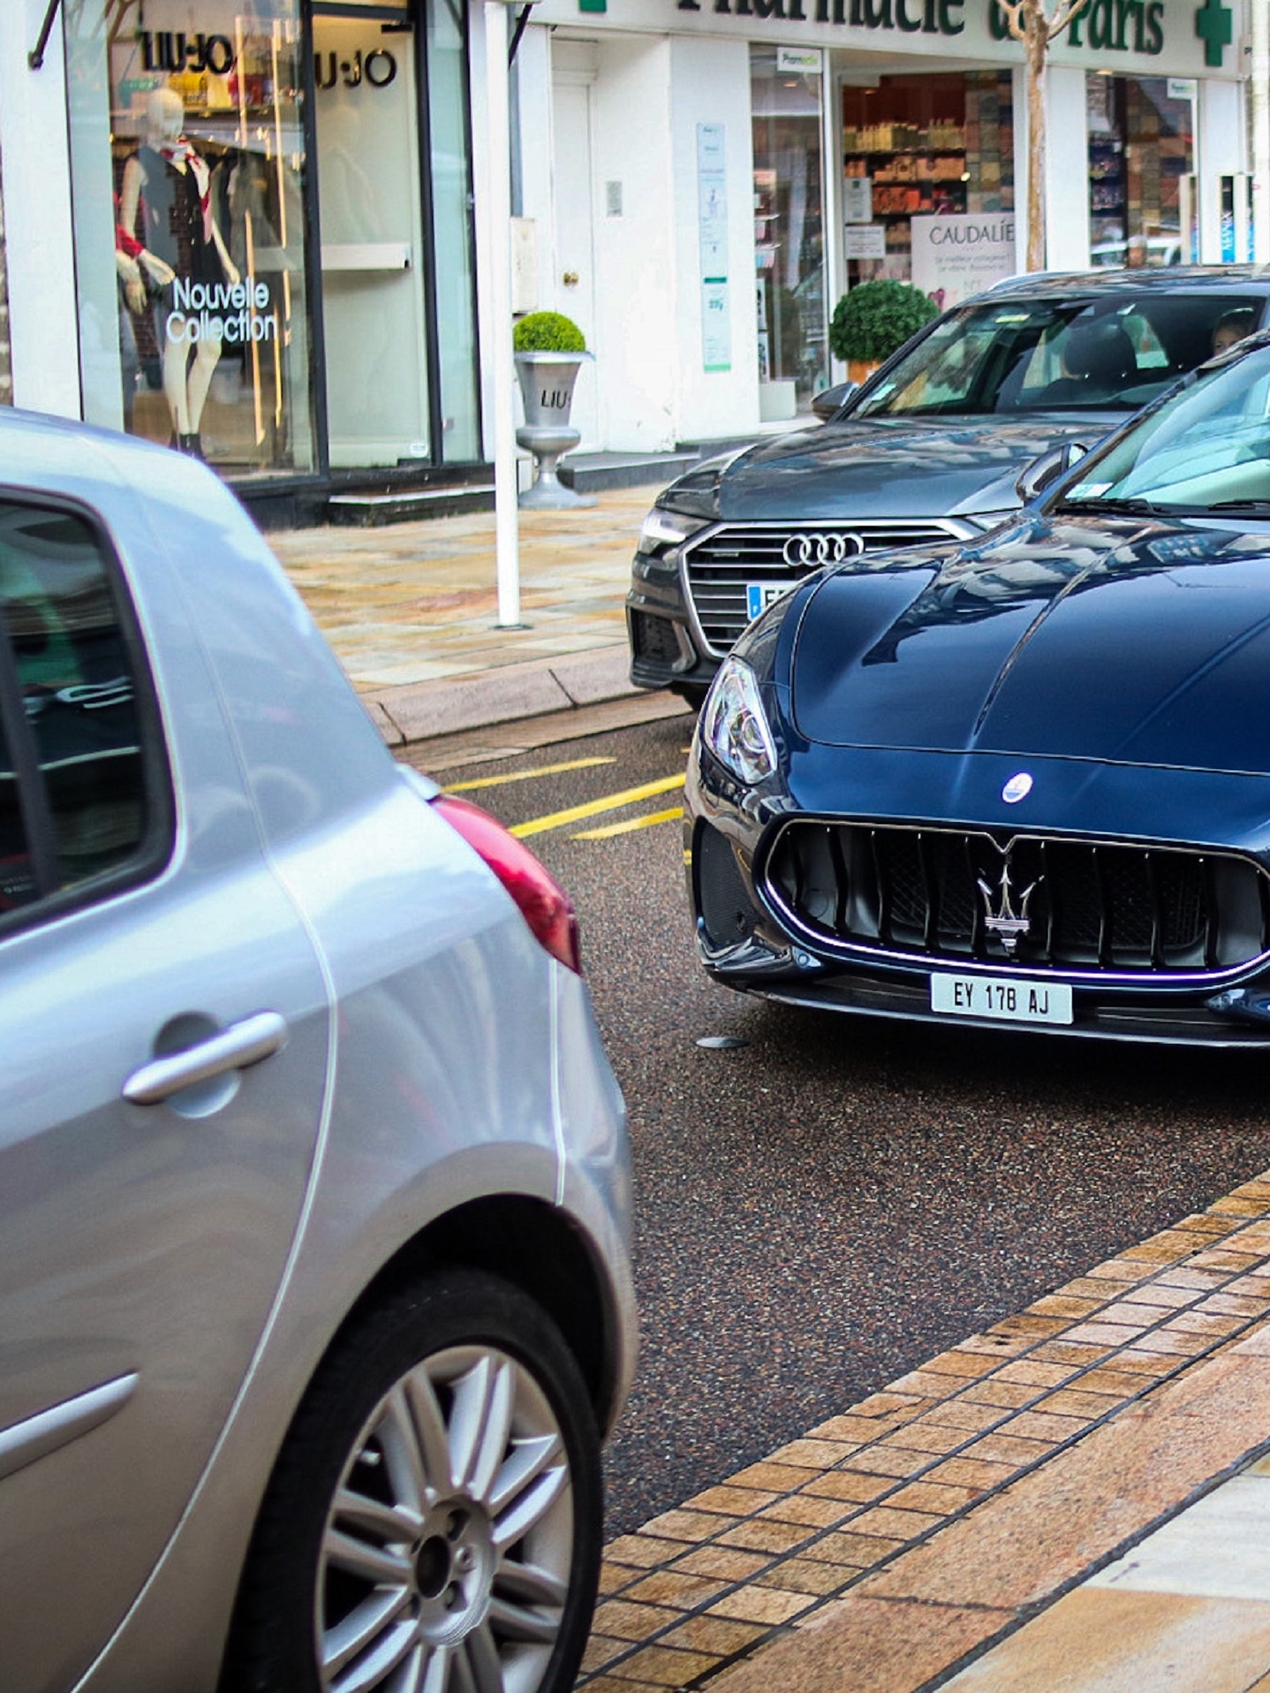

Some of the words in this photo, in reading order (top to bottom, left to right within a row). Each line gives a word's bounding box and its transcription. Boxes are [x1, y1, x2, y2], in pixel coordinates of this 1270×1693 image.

[678, 0, 964, 35] macie
[173, 276, 270, 310] Nouvelle
[166, 309, 279, 344] Collection
[954, 982, 974, 1007] EY
[986, 984, 1016, 1011] 178
[1029, 989, 1048, 1014] AJ
